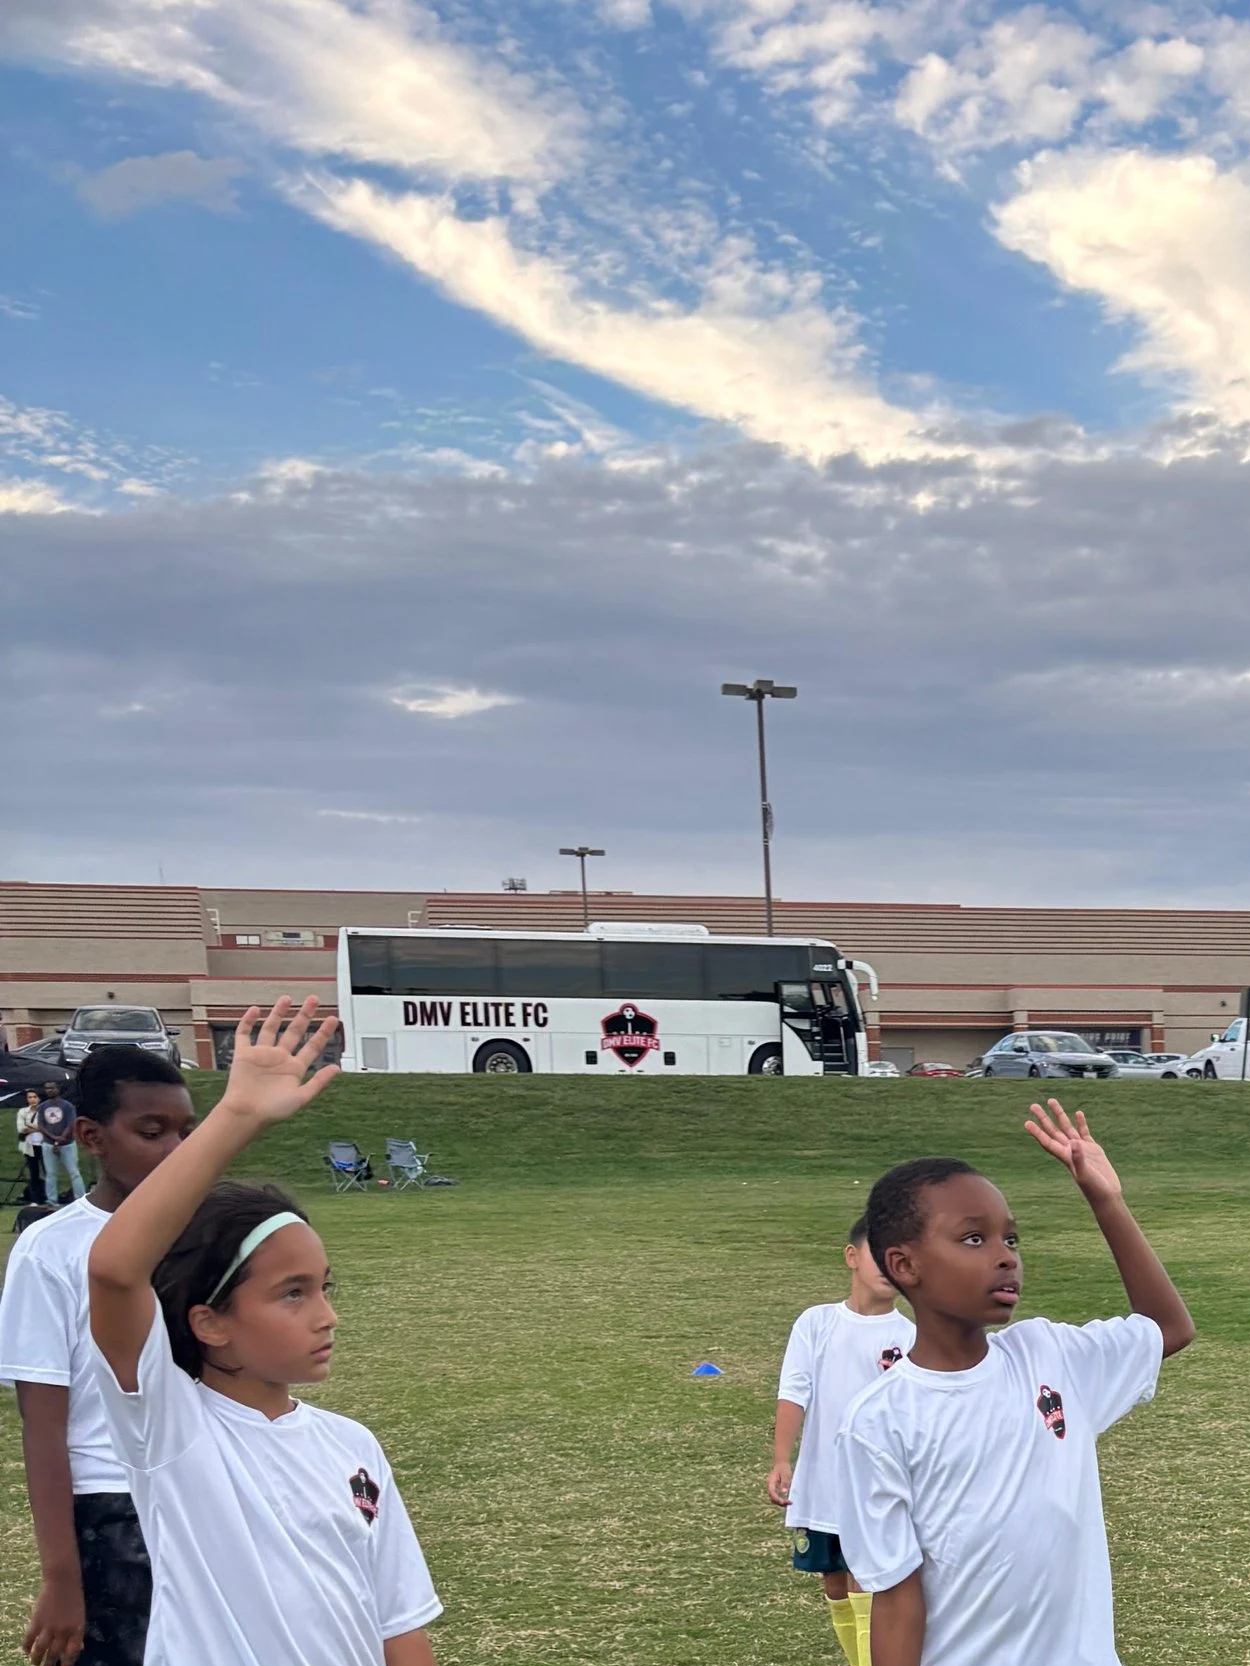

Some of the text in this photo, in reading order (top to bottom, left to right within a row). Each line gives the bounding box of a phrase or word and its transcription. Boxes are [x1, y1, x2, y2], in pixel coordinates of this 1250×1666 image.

[403, 1001, 548, 1028] DMV ELITE FC
[623, 1035, 647, 1046] ELITE
